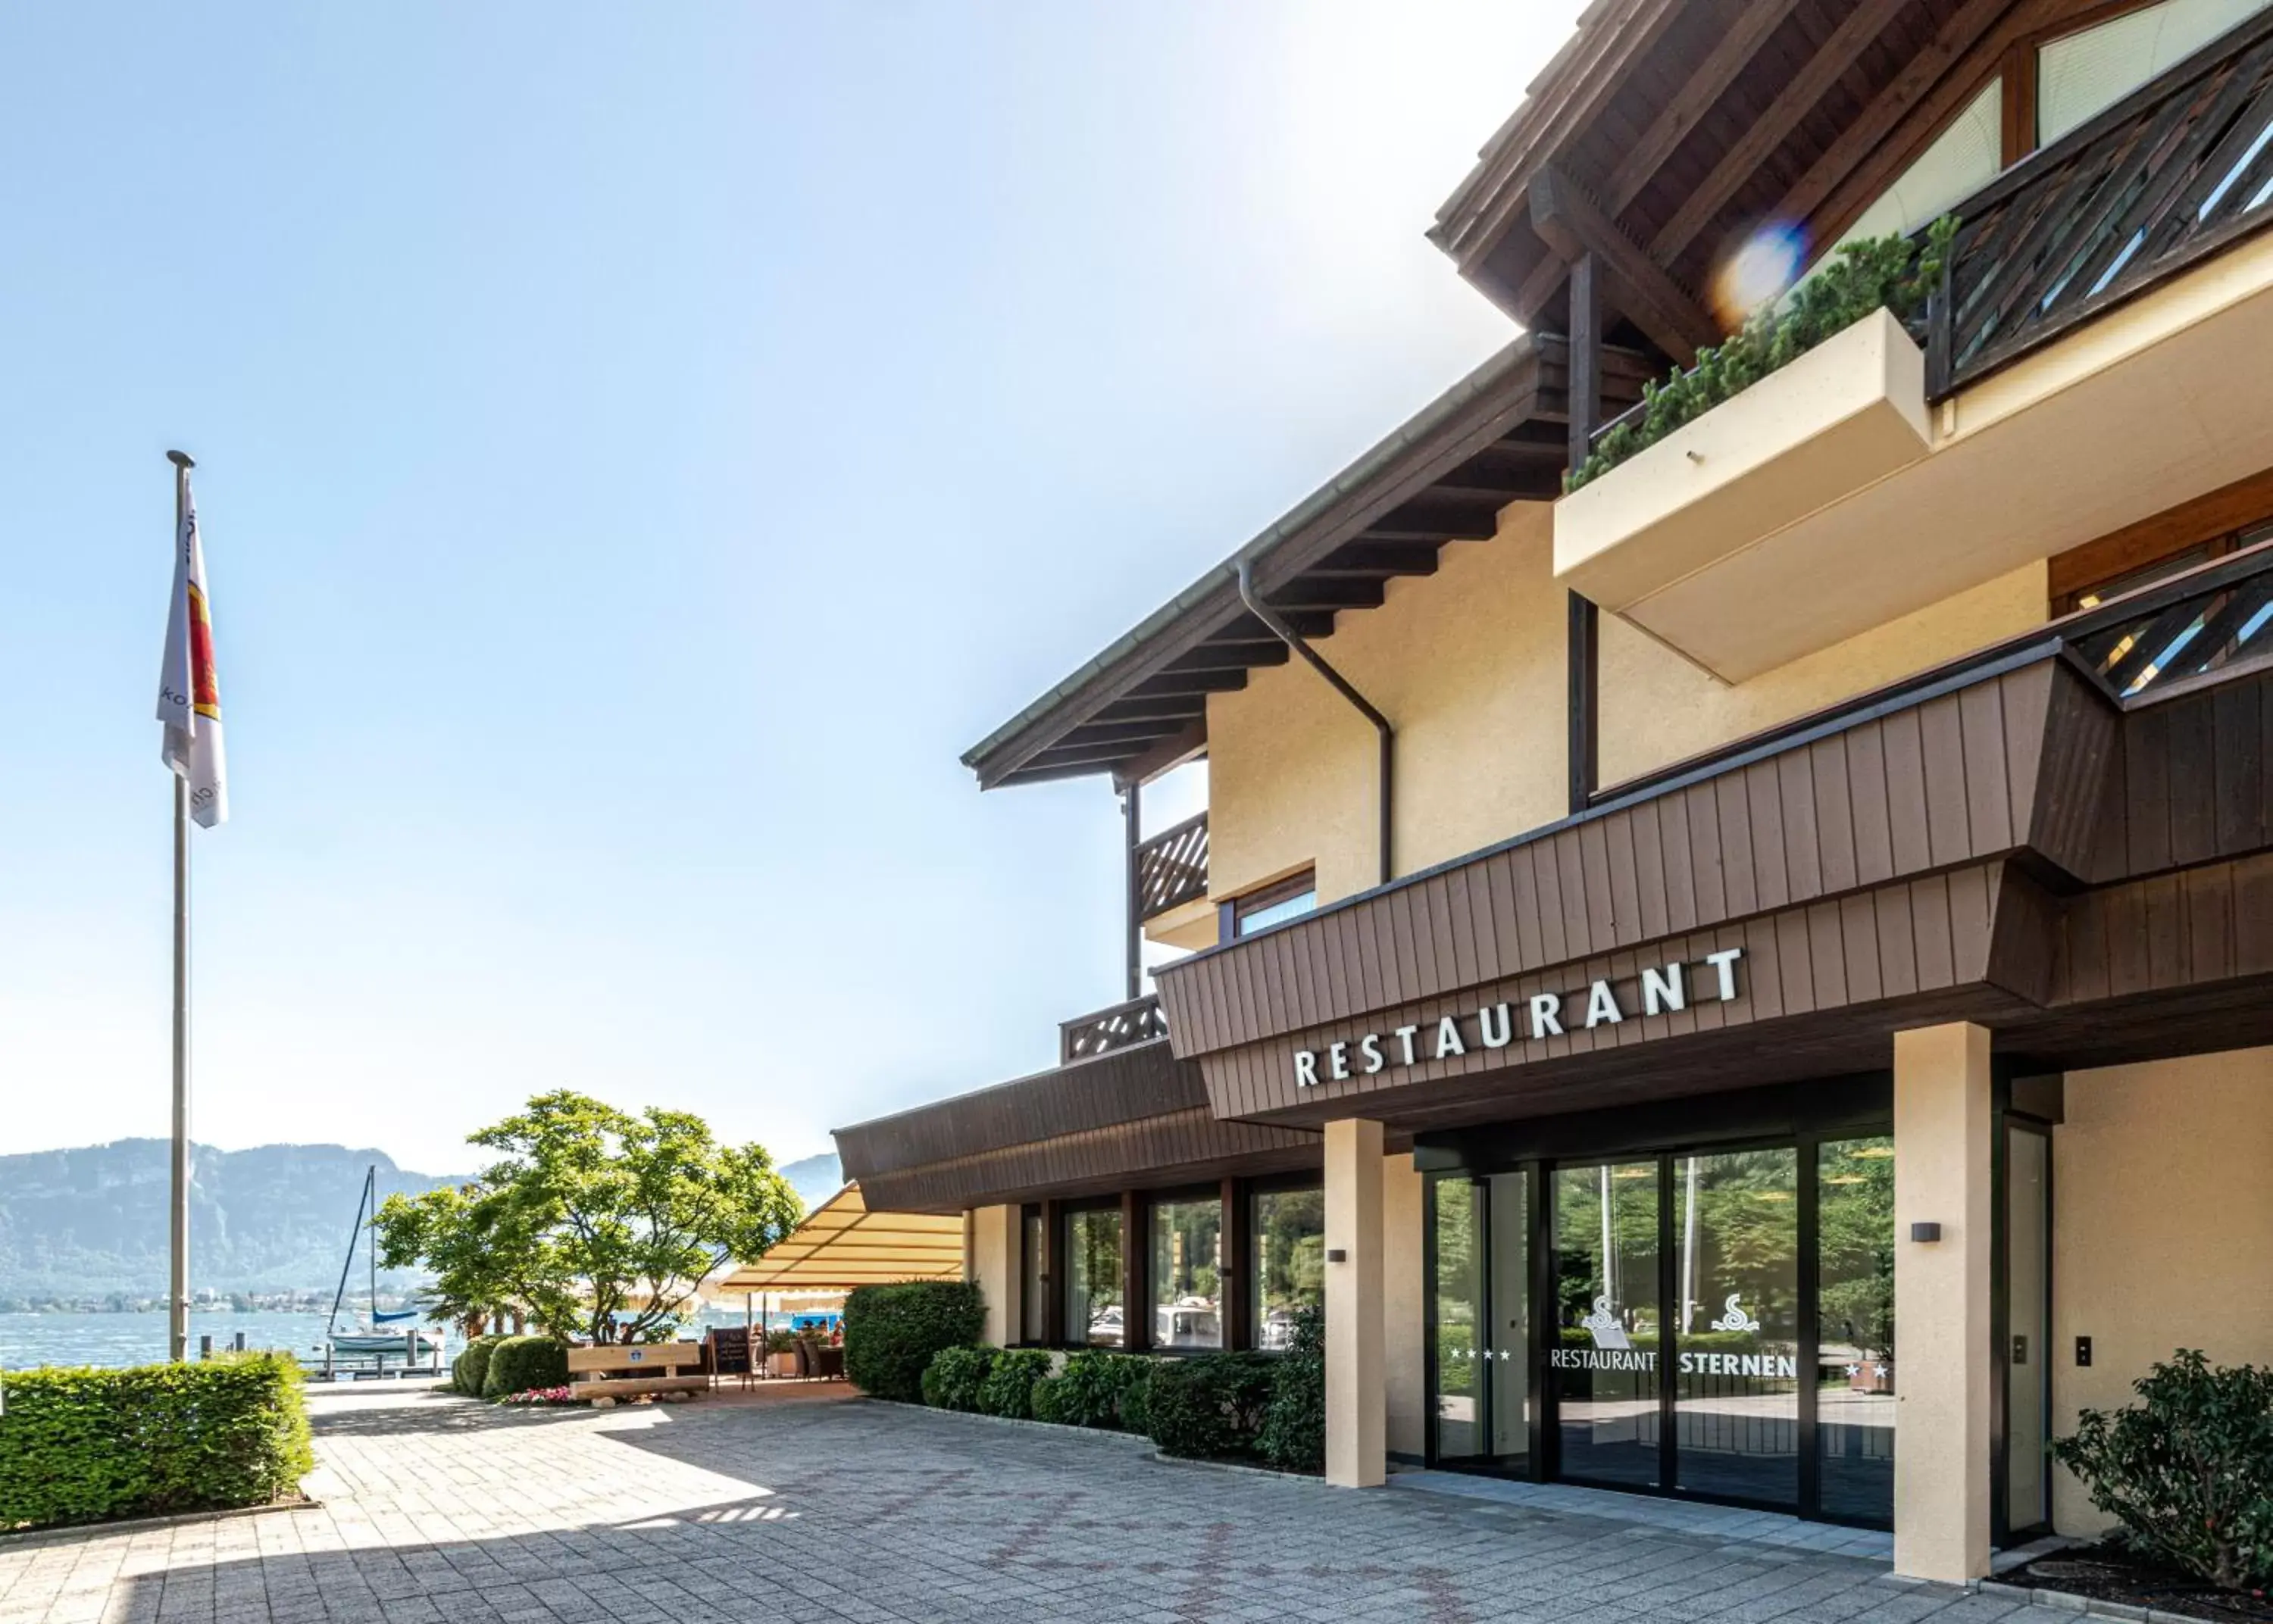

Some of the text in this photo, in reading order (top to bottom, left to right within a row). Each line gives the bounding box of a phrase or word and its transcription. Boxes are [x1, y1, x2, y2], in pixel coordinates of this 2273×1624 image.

[1294, 948, 1742, 1088] RESTAURANT
[1551, 1349, 1797, 1377] RESTAURANT STERNEN
